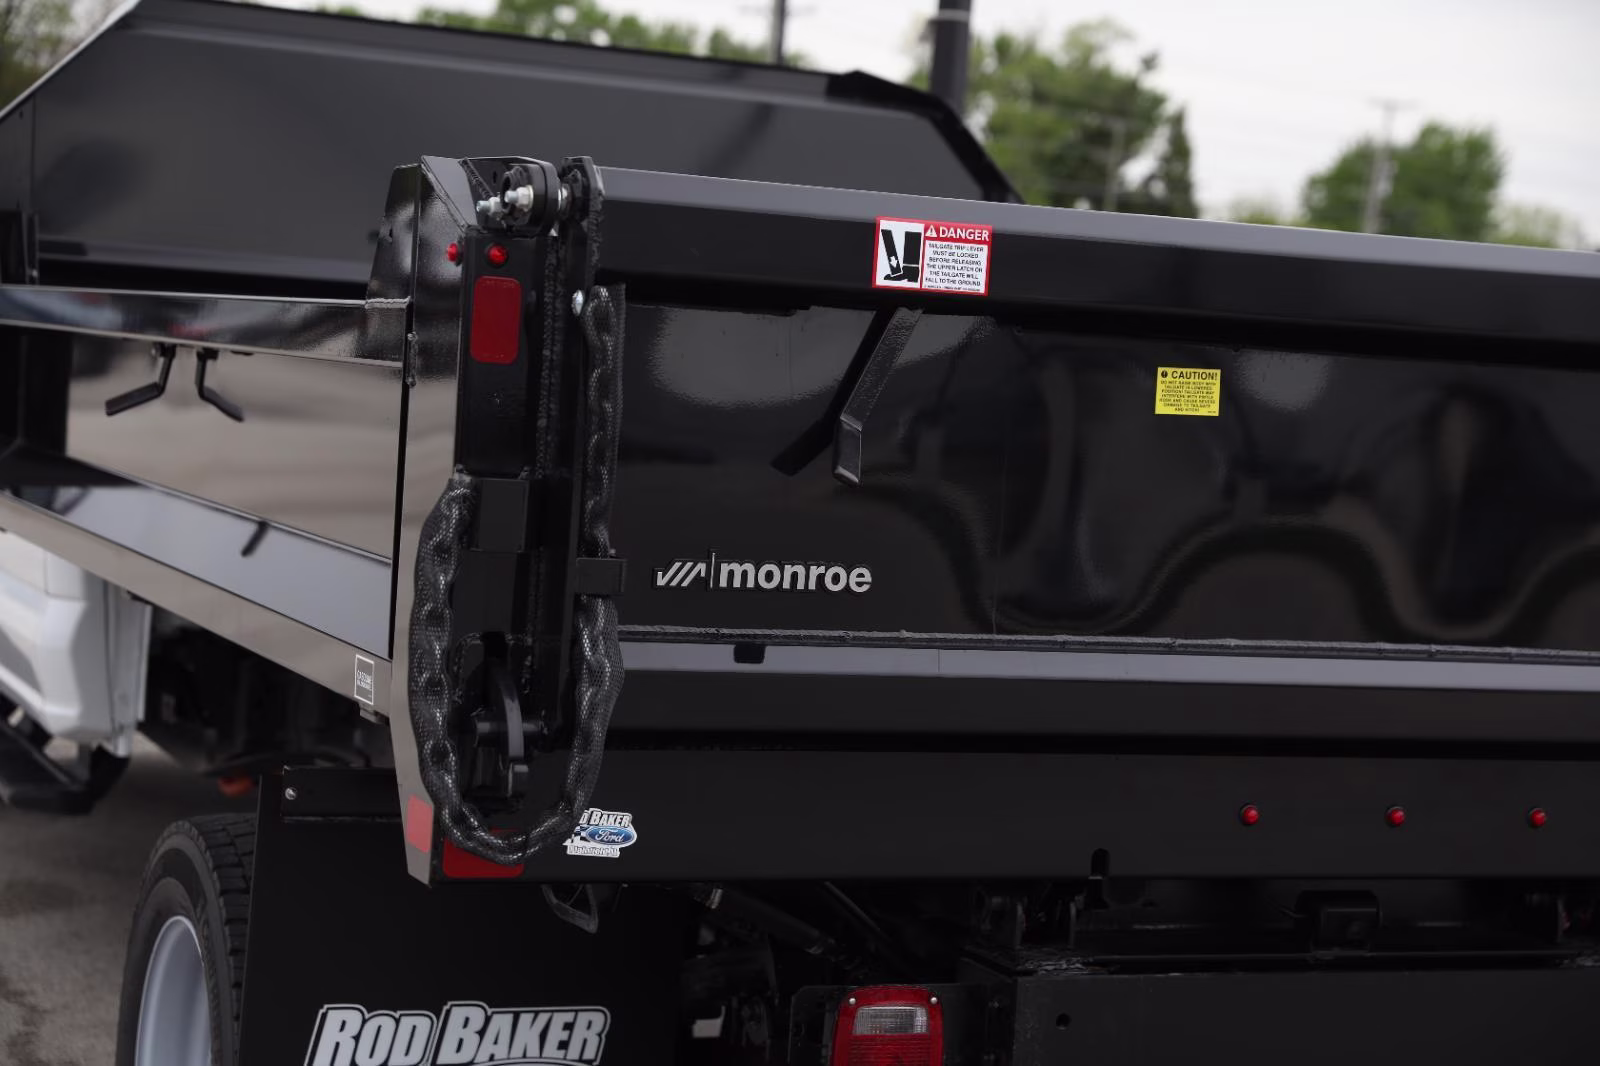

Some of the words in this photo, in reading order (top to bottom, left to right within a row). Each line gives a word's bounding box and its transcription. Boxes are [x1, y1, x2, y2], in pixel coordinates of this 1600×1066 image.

[940, 226, 989, 241] DANGER
[1171, 370, 1218, 381] CAUTION!
[719, 561, 873, 593] monroe
[589, 811, 630, 828] BAKER
[595, 829, 626, 843] Ford
[311, 1008, 434, 1066] ROD
[436, 1005, 602, 1065] BAKER
